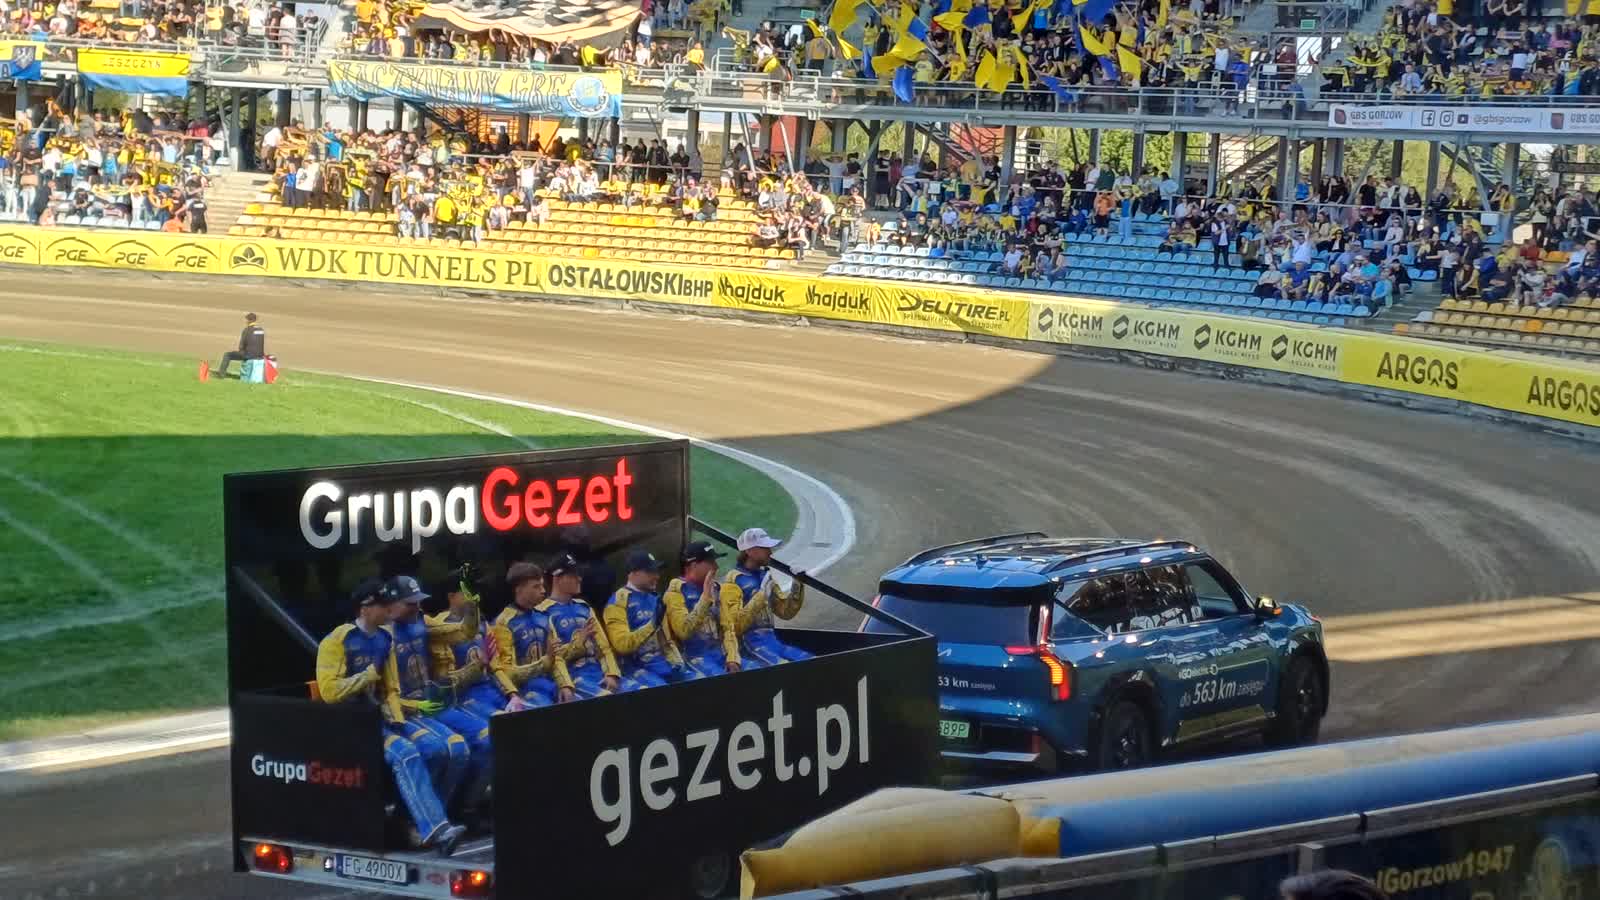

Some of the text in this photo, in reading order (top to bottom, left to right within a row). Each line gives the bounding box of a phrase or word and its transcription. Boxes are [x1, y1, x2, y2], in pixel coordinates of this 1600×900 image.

[55, 249, 89, 262] PGE
[114, 251, 148, 265] PGE
[174, 254, 209, 268] PGE
[276, 247, 347, 274] WDK
[355, 251, 497, 284] TUNNELS
[1057, 311, 1105, 332] KGHM
[1133, 319, 1181, 341] KGHM
[1214, 330, 1263, 352] KGHM
[1292, 339, 1338, 362] KGHM
[1376, 351, 1460, 391] ARGOS
[1527, 374, 1600, 417] ARGOS
[952, 677, 969, 689] km
[1192, 679, 1217, 705] 563
[1217, 677, 1237, 701] km
[589, 674, 870, 847] gezet.pl
[342, 855, 361, 870] FG
